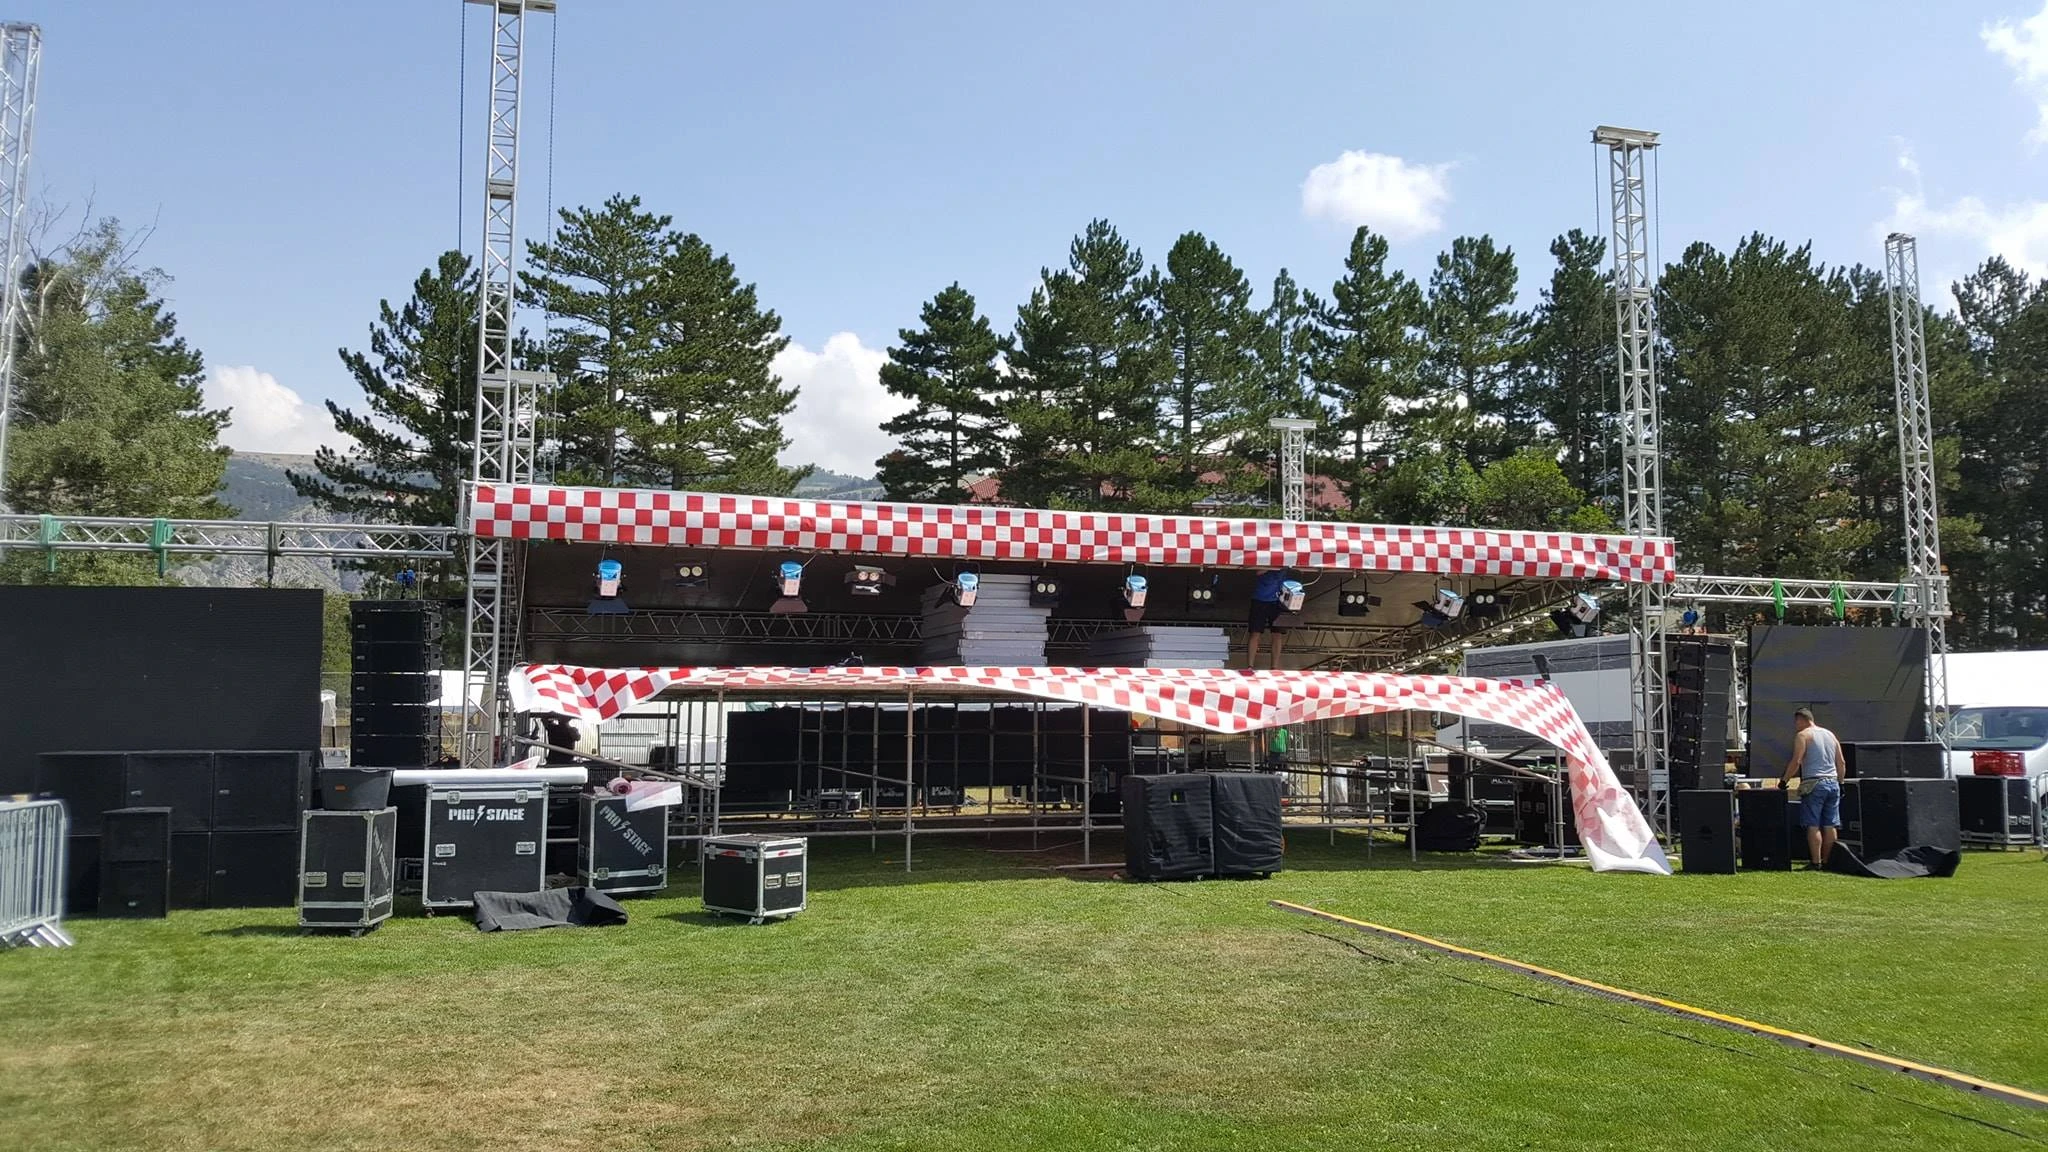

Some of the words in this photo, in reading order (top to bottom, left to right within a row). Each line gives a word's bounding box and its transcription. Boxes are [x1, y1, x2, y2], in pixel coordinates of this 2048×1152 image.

[448, 808, 475, 821] PRO
[486, 808, 525, 821] STAGE
[600, 805, 621, 827] PRO
[623, 828, 652, 856] STAGE
